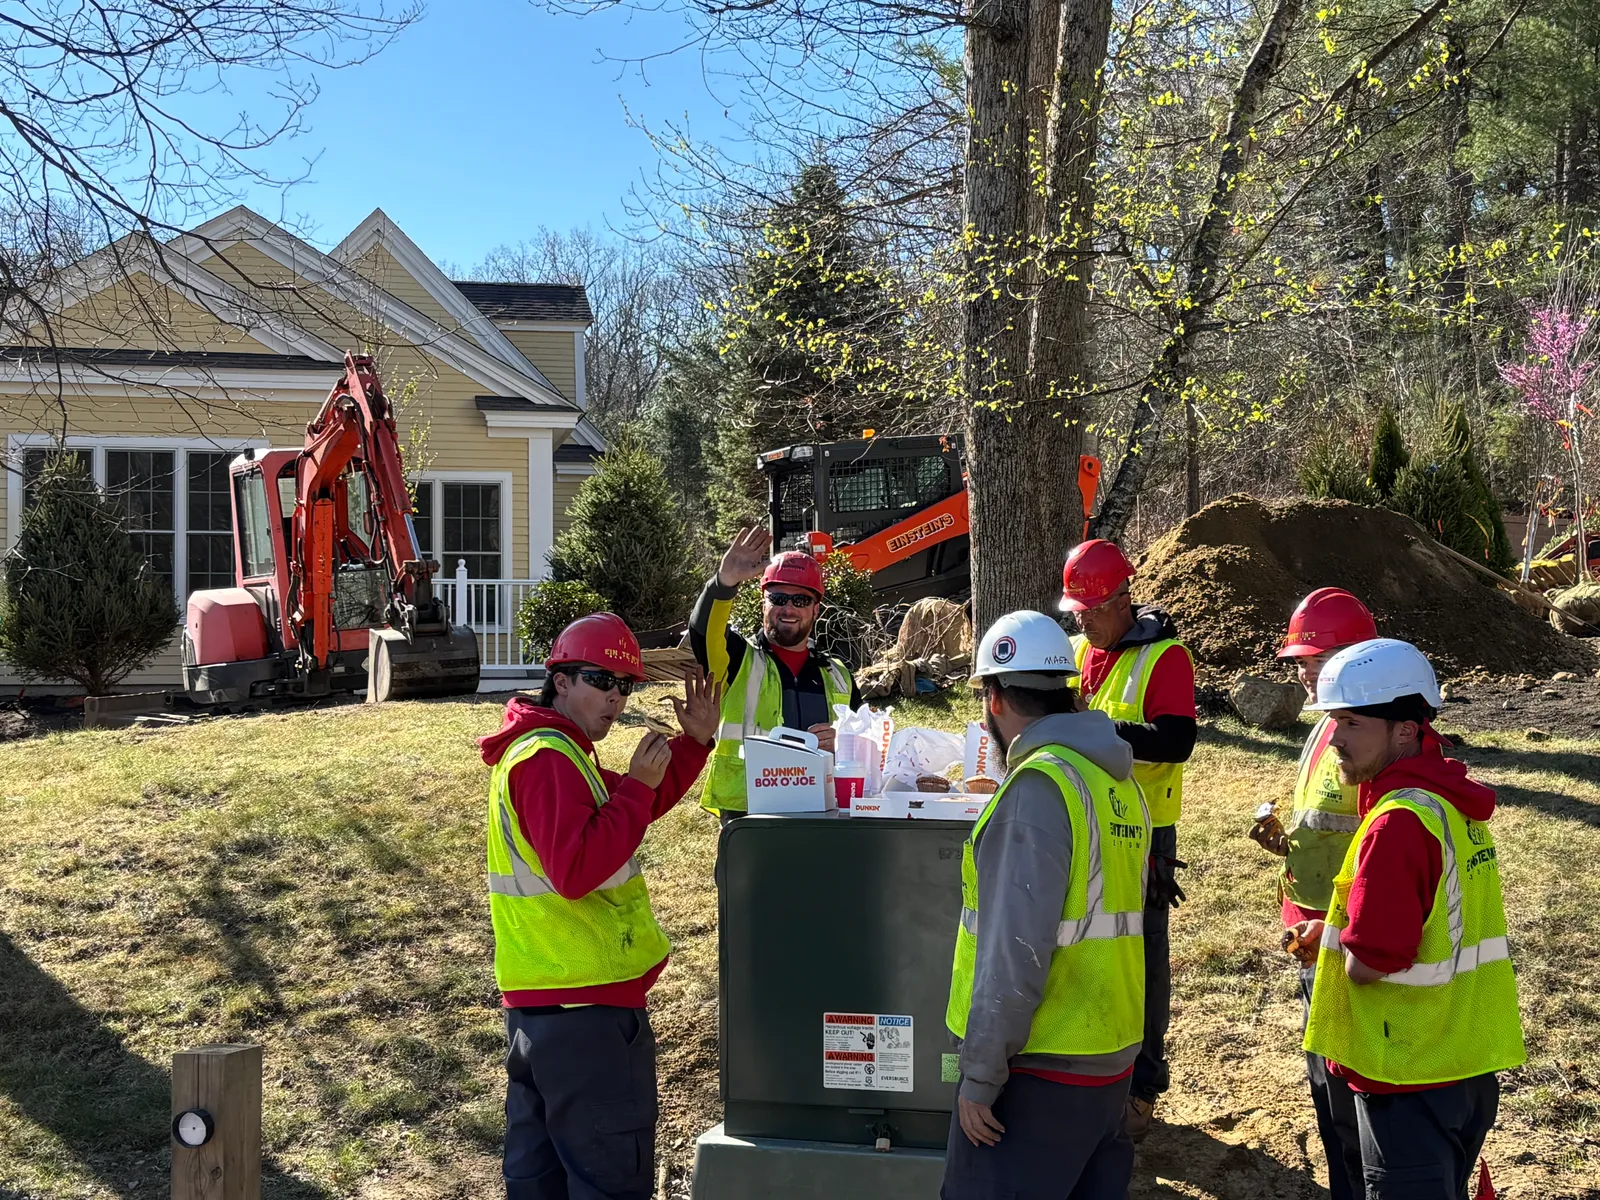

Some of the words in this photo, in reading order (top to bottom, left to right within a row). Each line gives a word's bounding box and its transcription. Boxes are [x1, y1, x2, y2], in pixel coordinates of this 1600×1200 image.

[887, 514, 953, 552] EINSTEIN'S
[975, 735, 989, 775] DUNK
[762, 766, 808, 778] DUNKIN'
[754, 777, 778, 788] BOX
[833, 1016, 873, 1025] WARNING
[880, 1017, 910, 1026] NOTICE
[833, 1053, 873, 1062] WARNING
